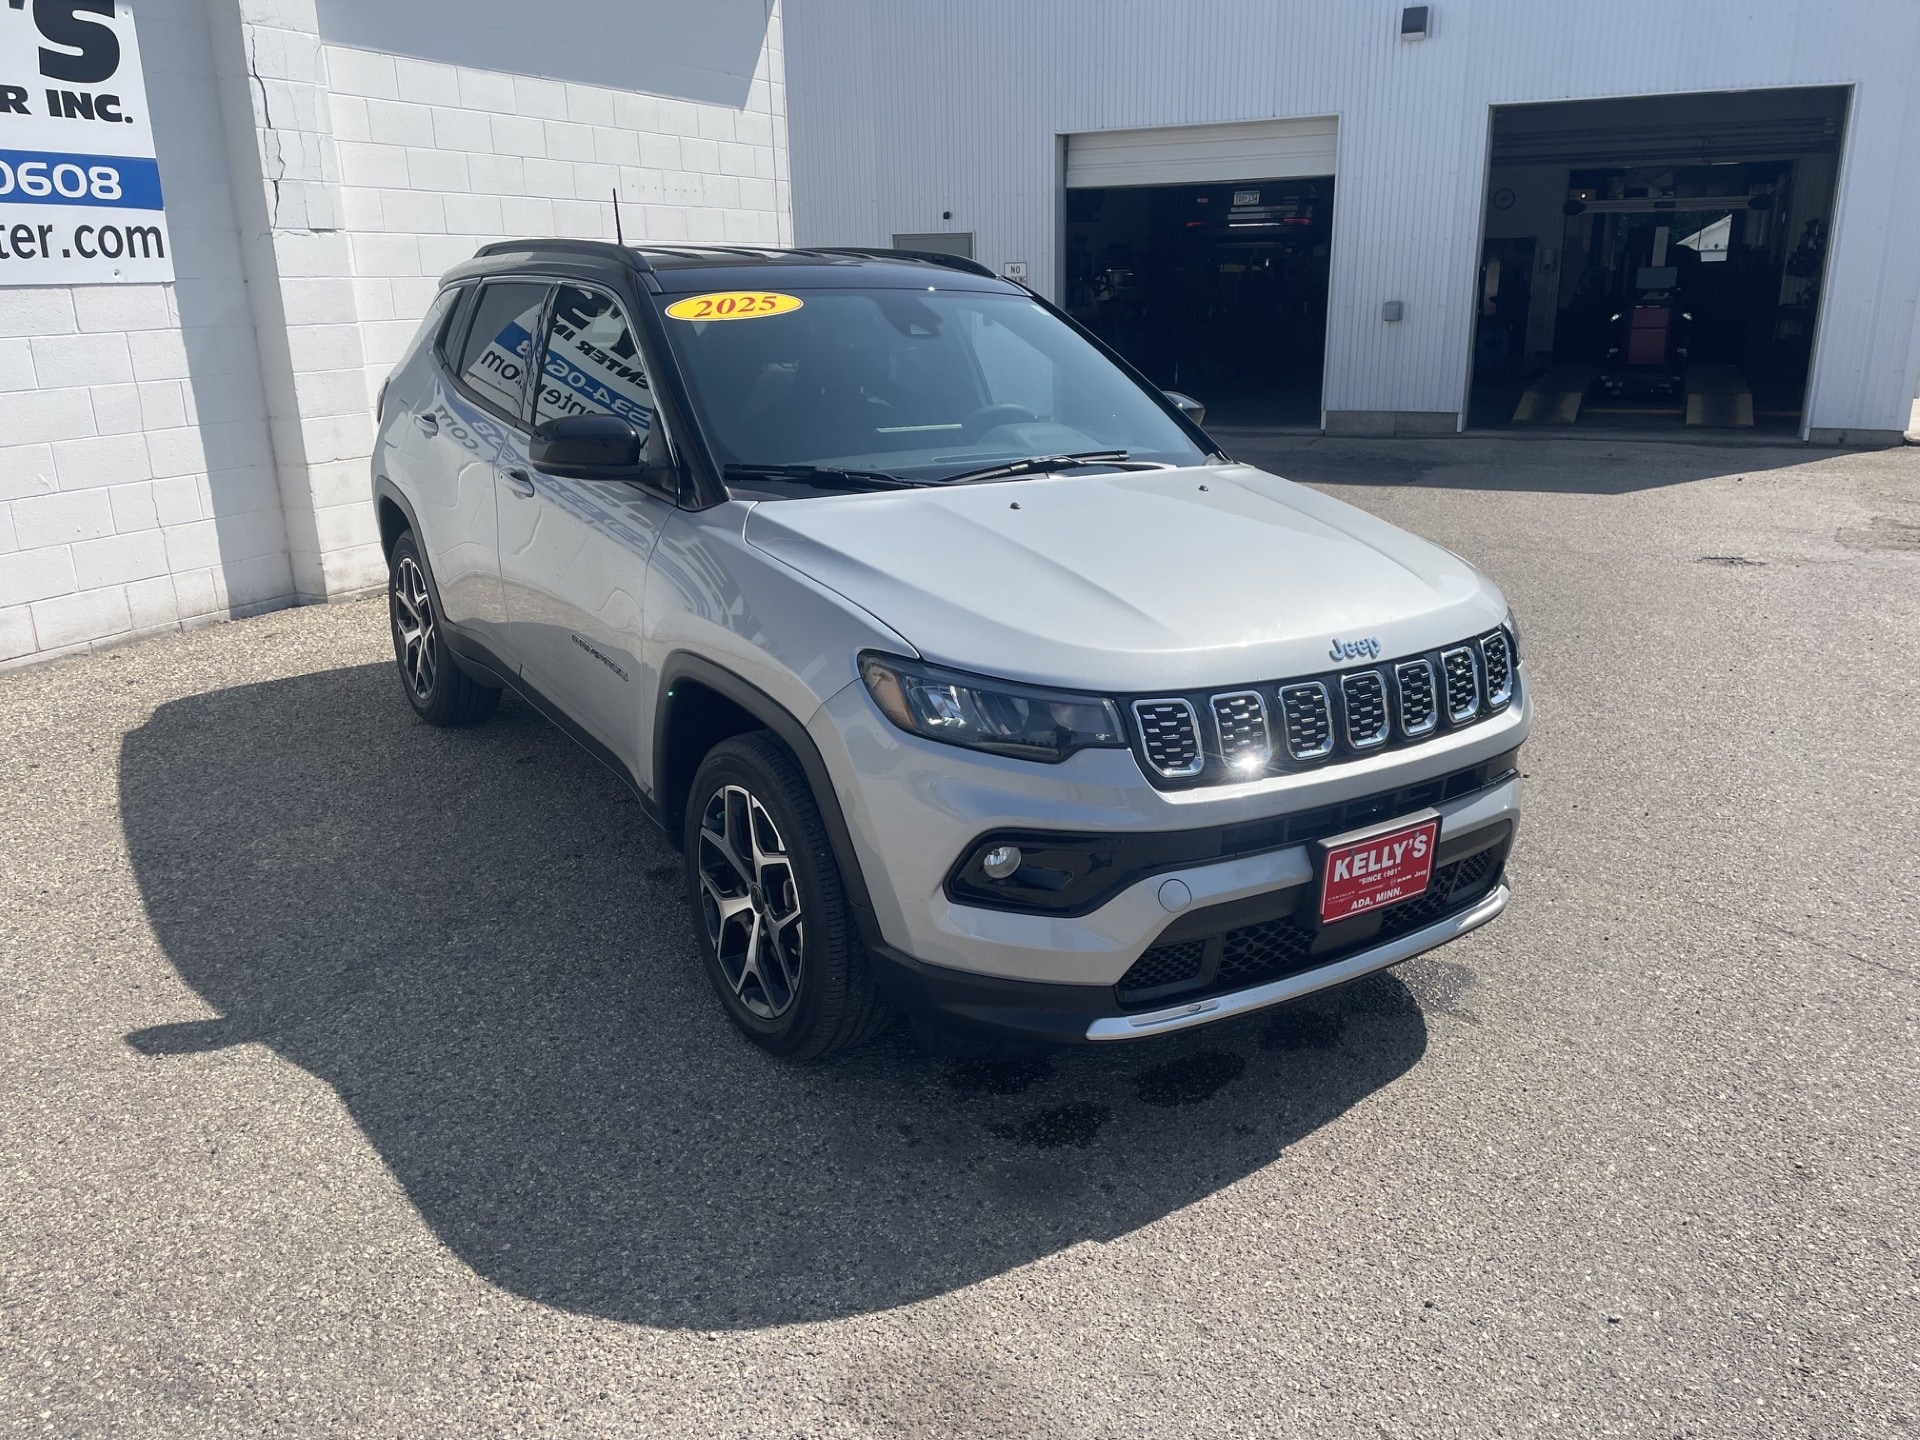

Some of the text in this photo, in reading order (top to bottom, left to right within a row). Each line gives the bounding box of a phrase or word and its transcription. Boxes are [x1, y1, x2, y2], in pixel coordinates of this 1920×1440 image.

[45, 89, 134, 123] INC.
[1010, 265, 1021, 274] NO
[693, 296, 777, 318] 2025
[1329, 637, 1382, 662] Jeep
[1333, 834, 1428, 883] KELLY'S
[1351, 896, 1373, 910] ADA,
[1376, 887, 1402, 902] MINN.
